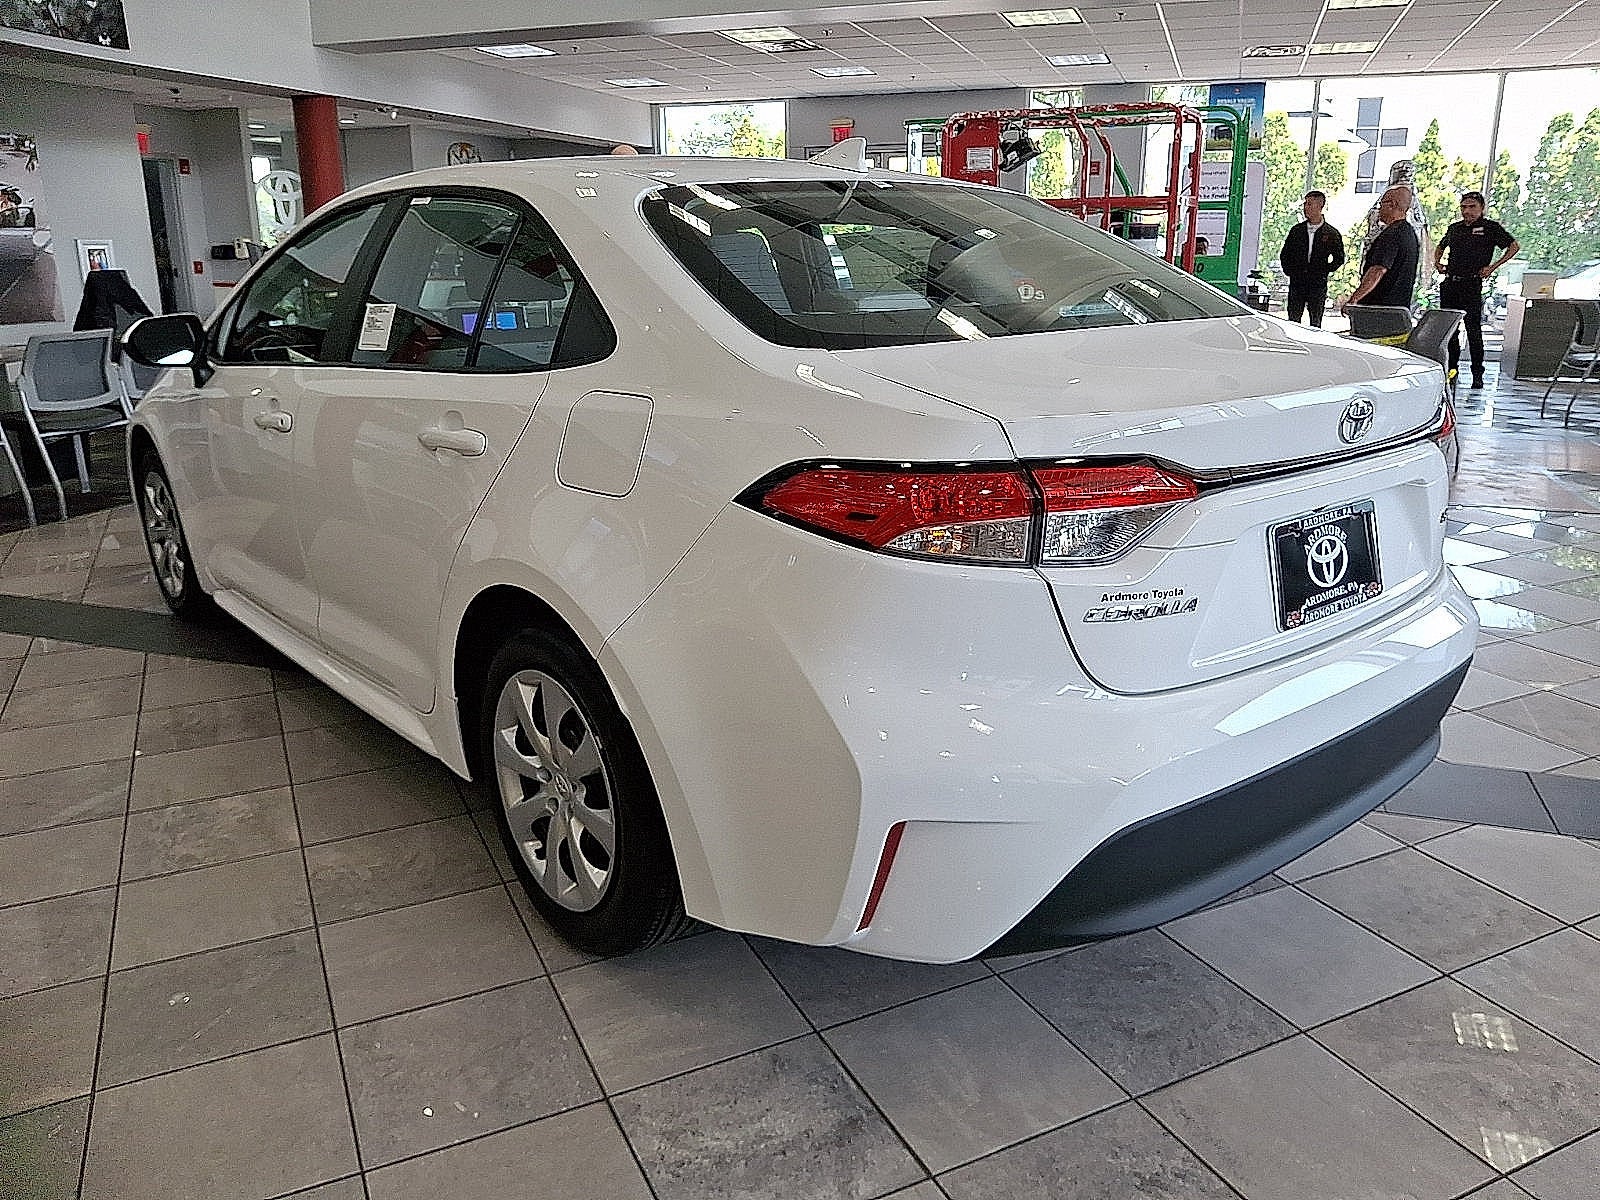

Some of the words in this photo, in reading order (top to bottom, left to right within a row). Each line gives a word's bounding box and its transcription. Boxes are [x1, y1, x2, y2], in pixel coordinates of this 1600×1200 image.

[1304, 524, 1348, 556] ARDMORE
[1101, 592, 1149, 602] Ardmore
[1152, 588, 1184, 600] Toyota
[1347, 581, 1359, 592] PA
[1082, 597, 1198, 622] COROLLA
[1304, 603, 1340, 623] ARDMORE
[1340, 594, 1368, 610] TOYOTA
